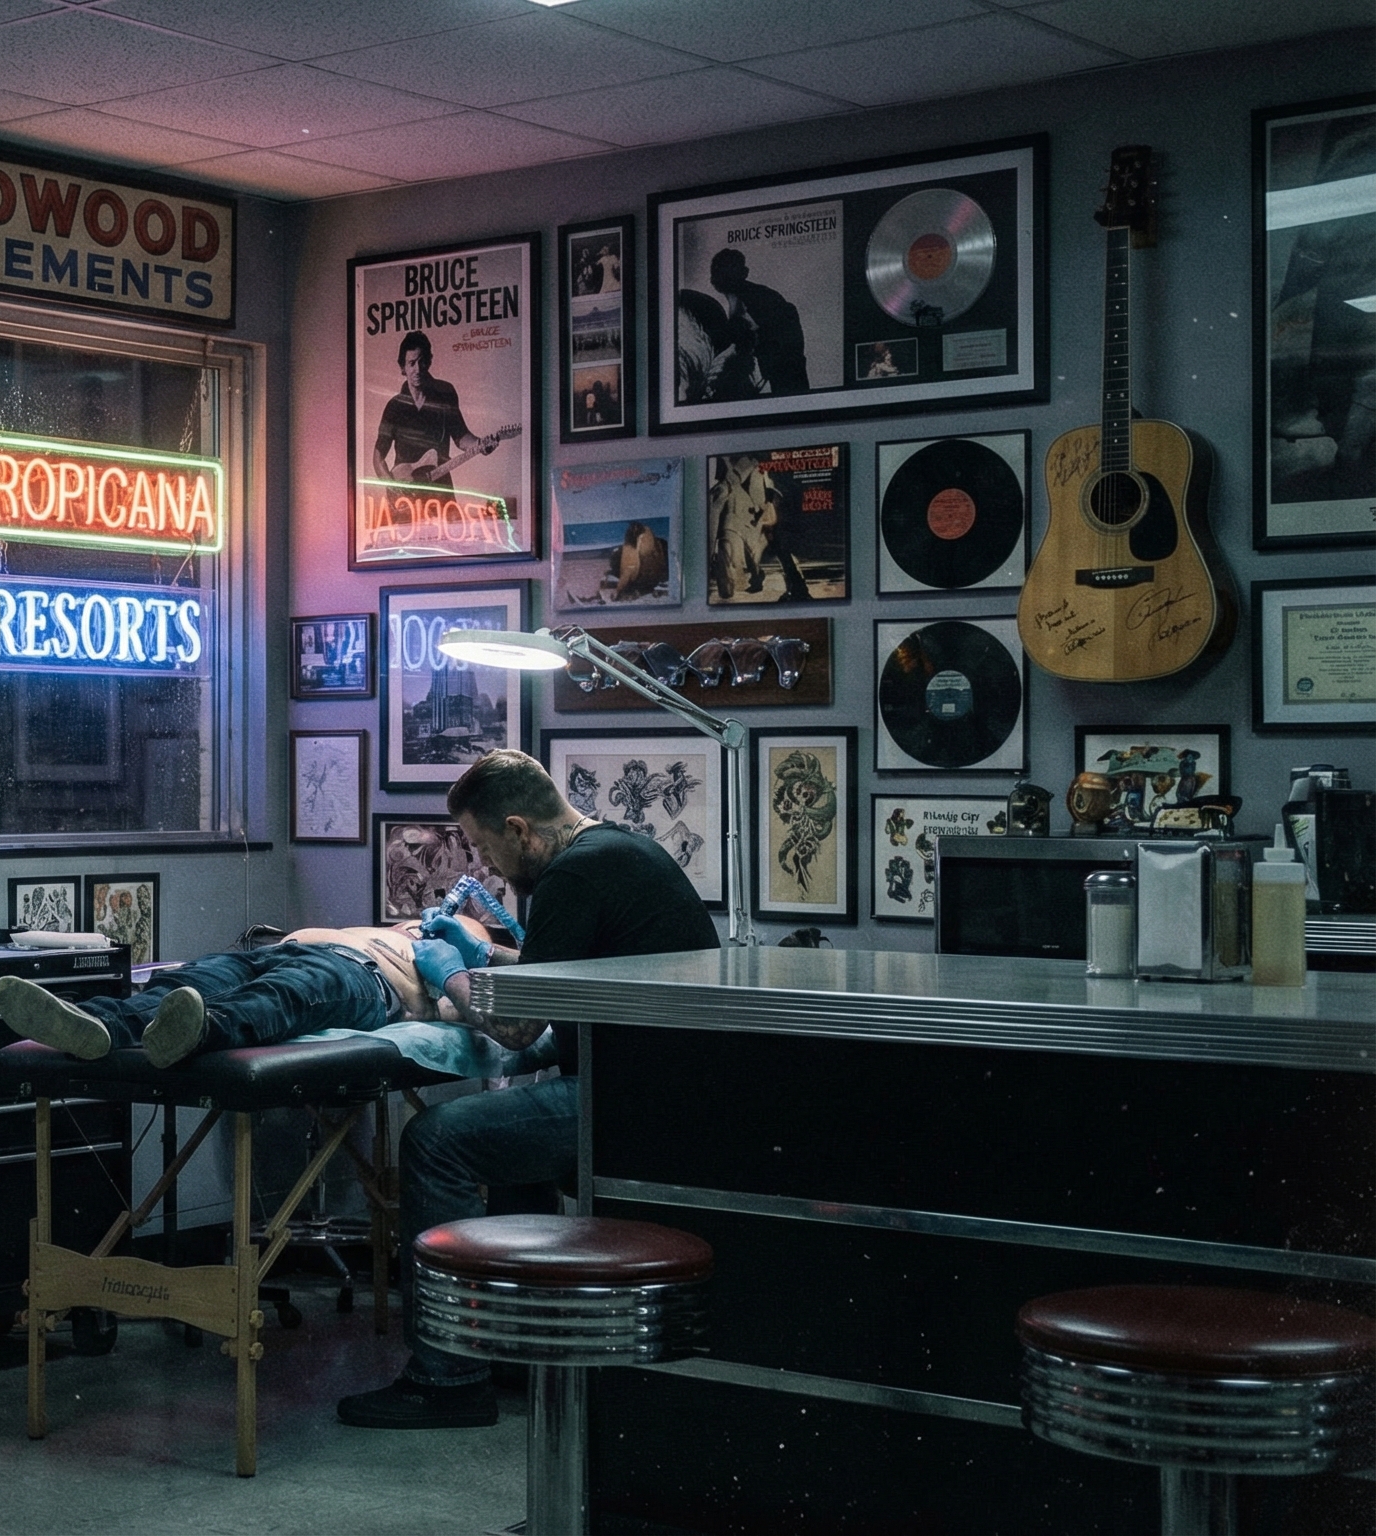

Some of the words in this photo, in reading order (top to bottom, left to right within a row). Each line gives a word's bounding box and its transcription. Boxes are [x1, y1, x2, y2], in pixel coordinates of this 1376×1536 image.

[727, 226, 763, 244] BRUCE
[405, 256, 479, 297] BRUCE
[367, 284, 519, 336] SPRINGSTEEN
